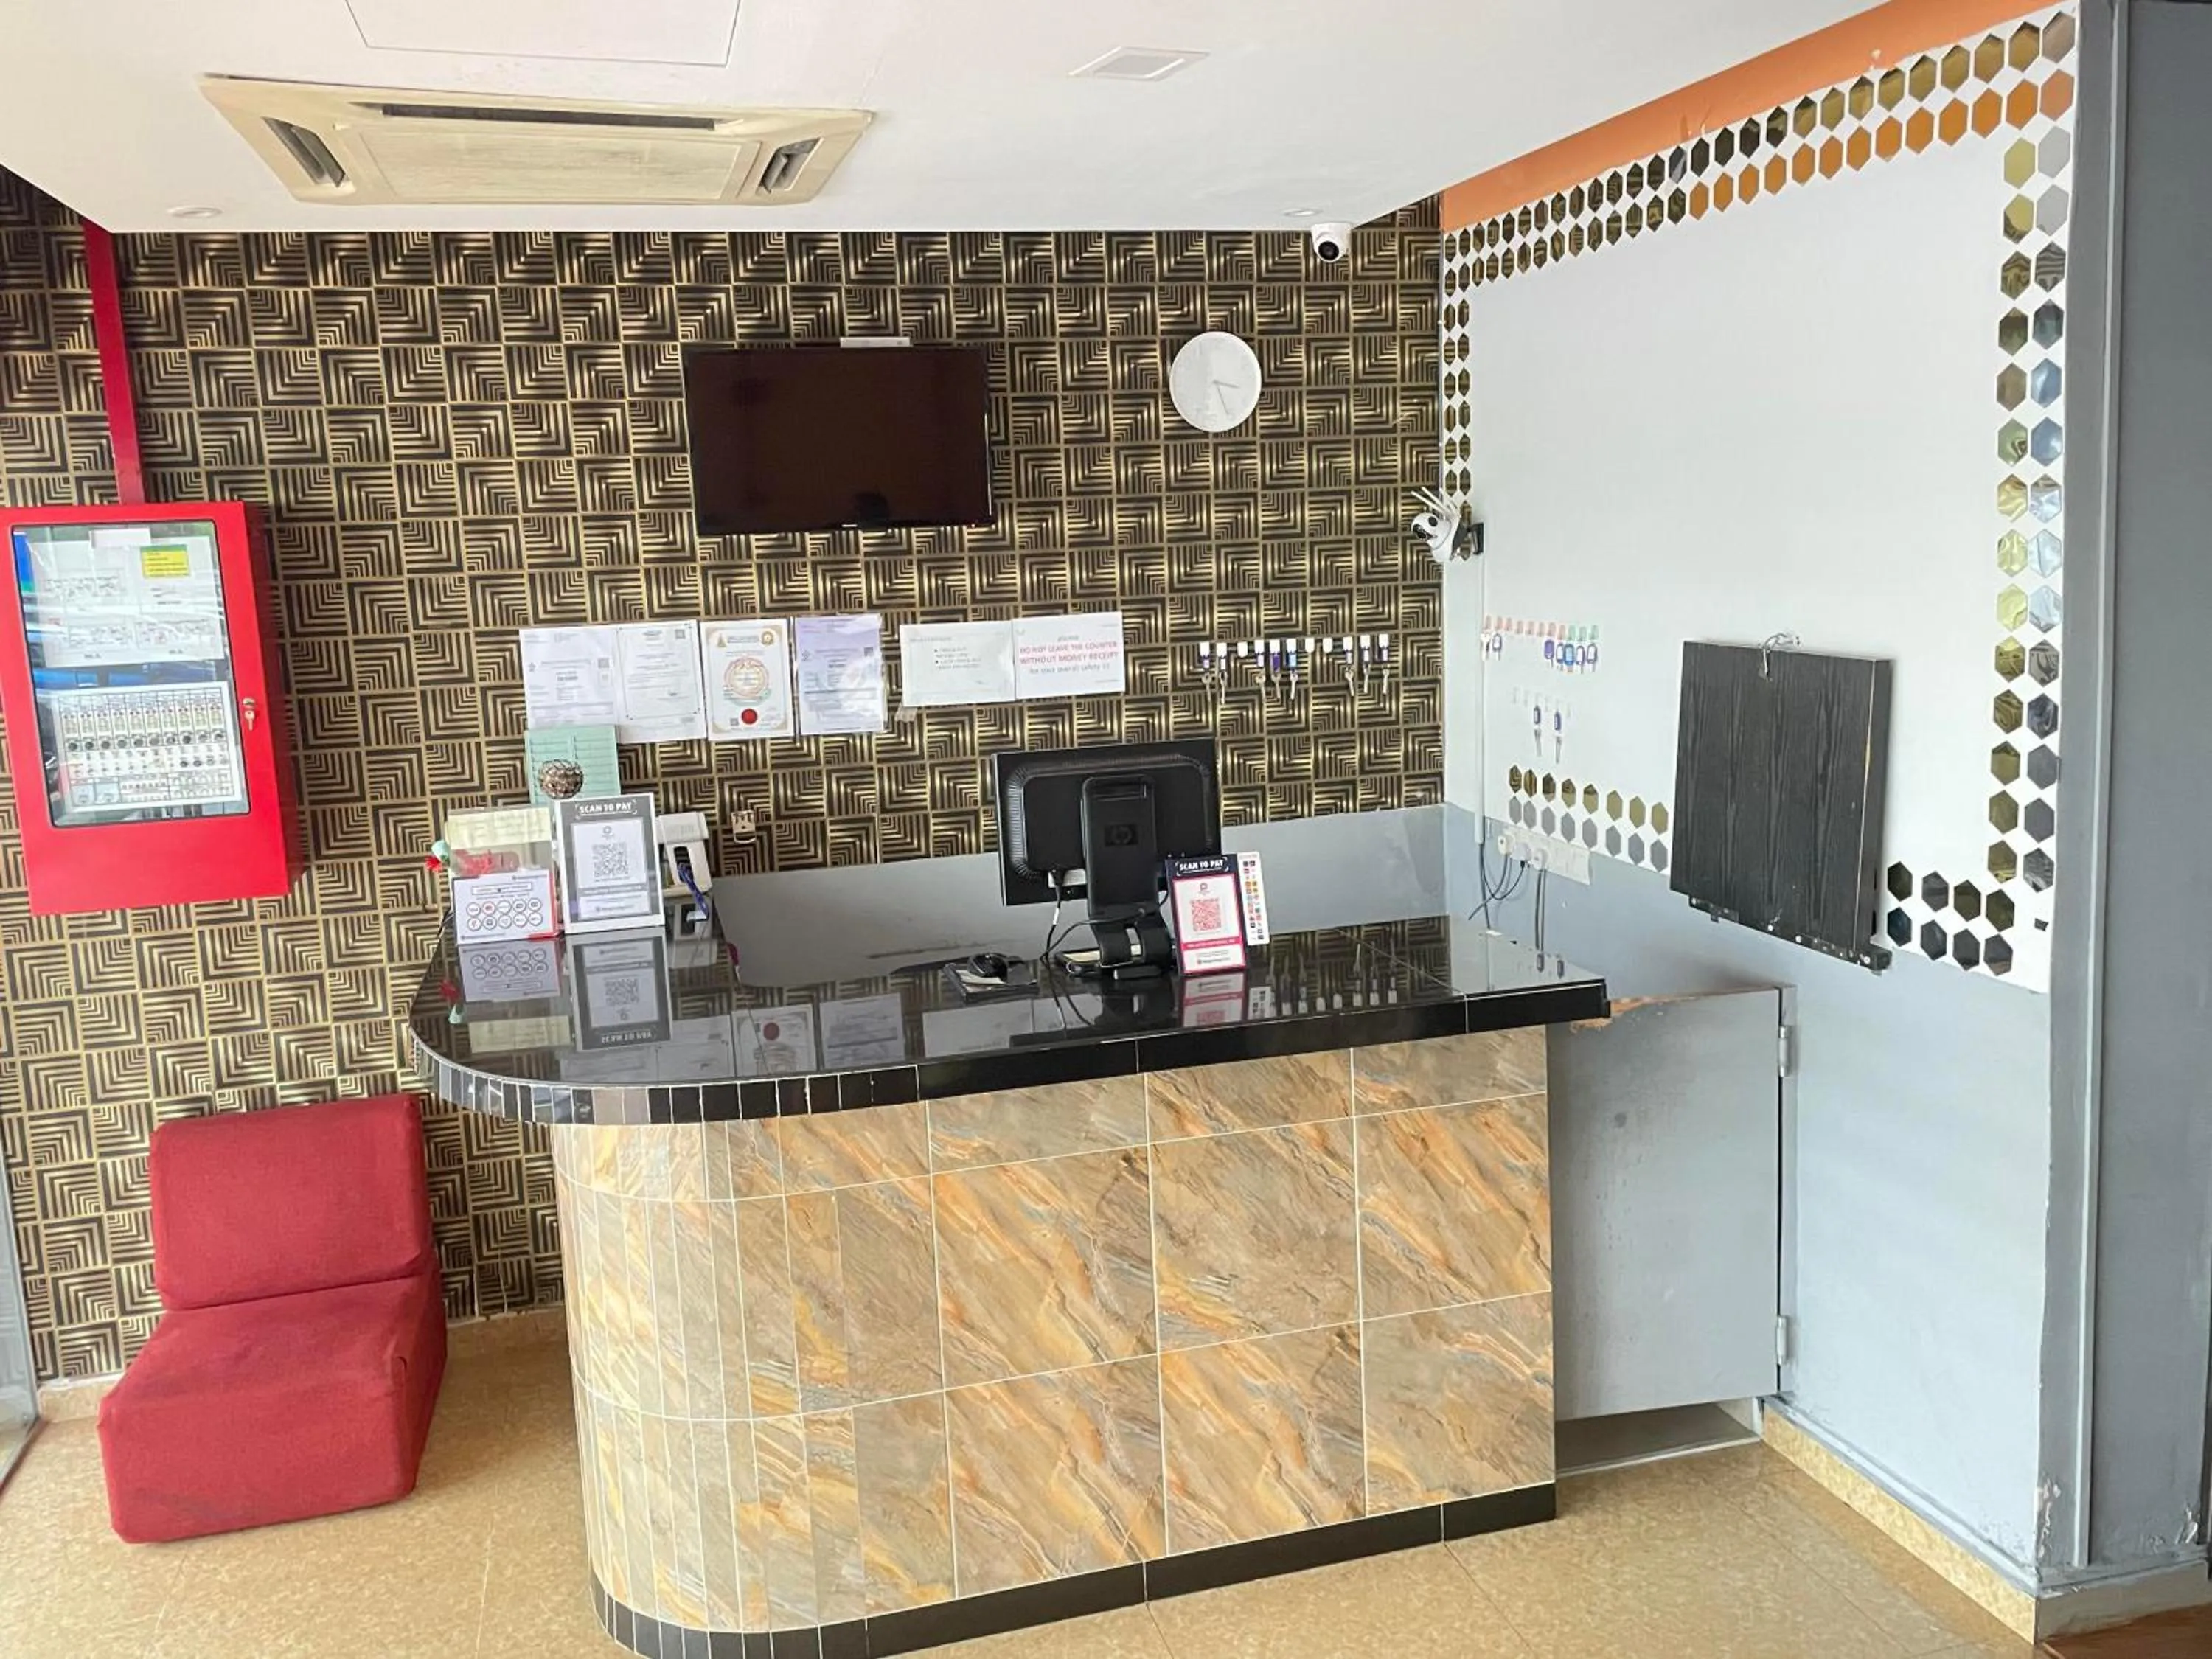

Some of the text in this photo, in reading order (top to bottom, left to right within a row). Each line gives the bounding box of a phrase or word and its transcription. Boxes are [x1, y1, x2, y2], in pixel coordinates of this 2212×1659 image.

[1048, 644, 1068, 652] LEAVE
[1085, 641, 1117, 650] COUNTER
[1020, 655, 1057, 664] WITHOUT
[1059, 653, 1086, 661] MONEY
[580, 804, 602, 813] SCAN
[616, 801, 632, 810] PAY
[1179, 862, 1198, 871] SCAN
